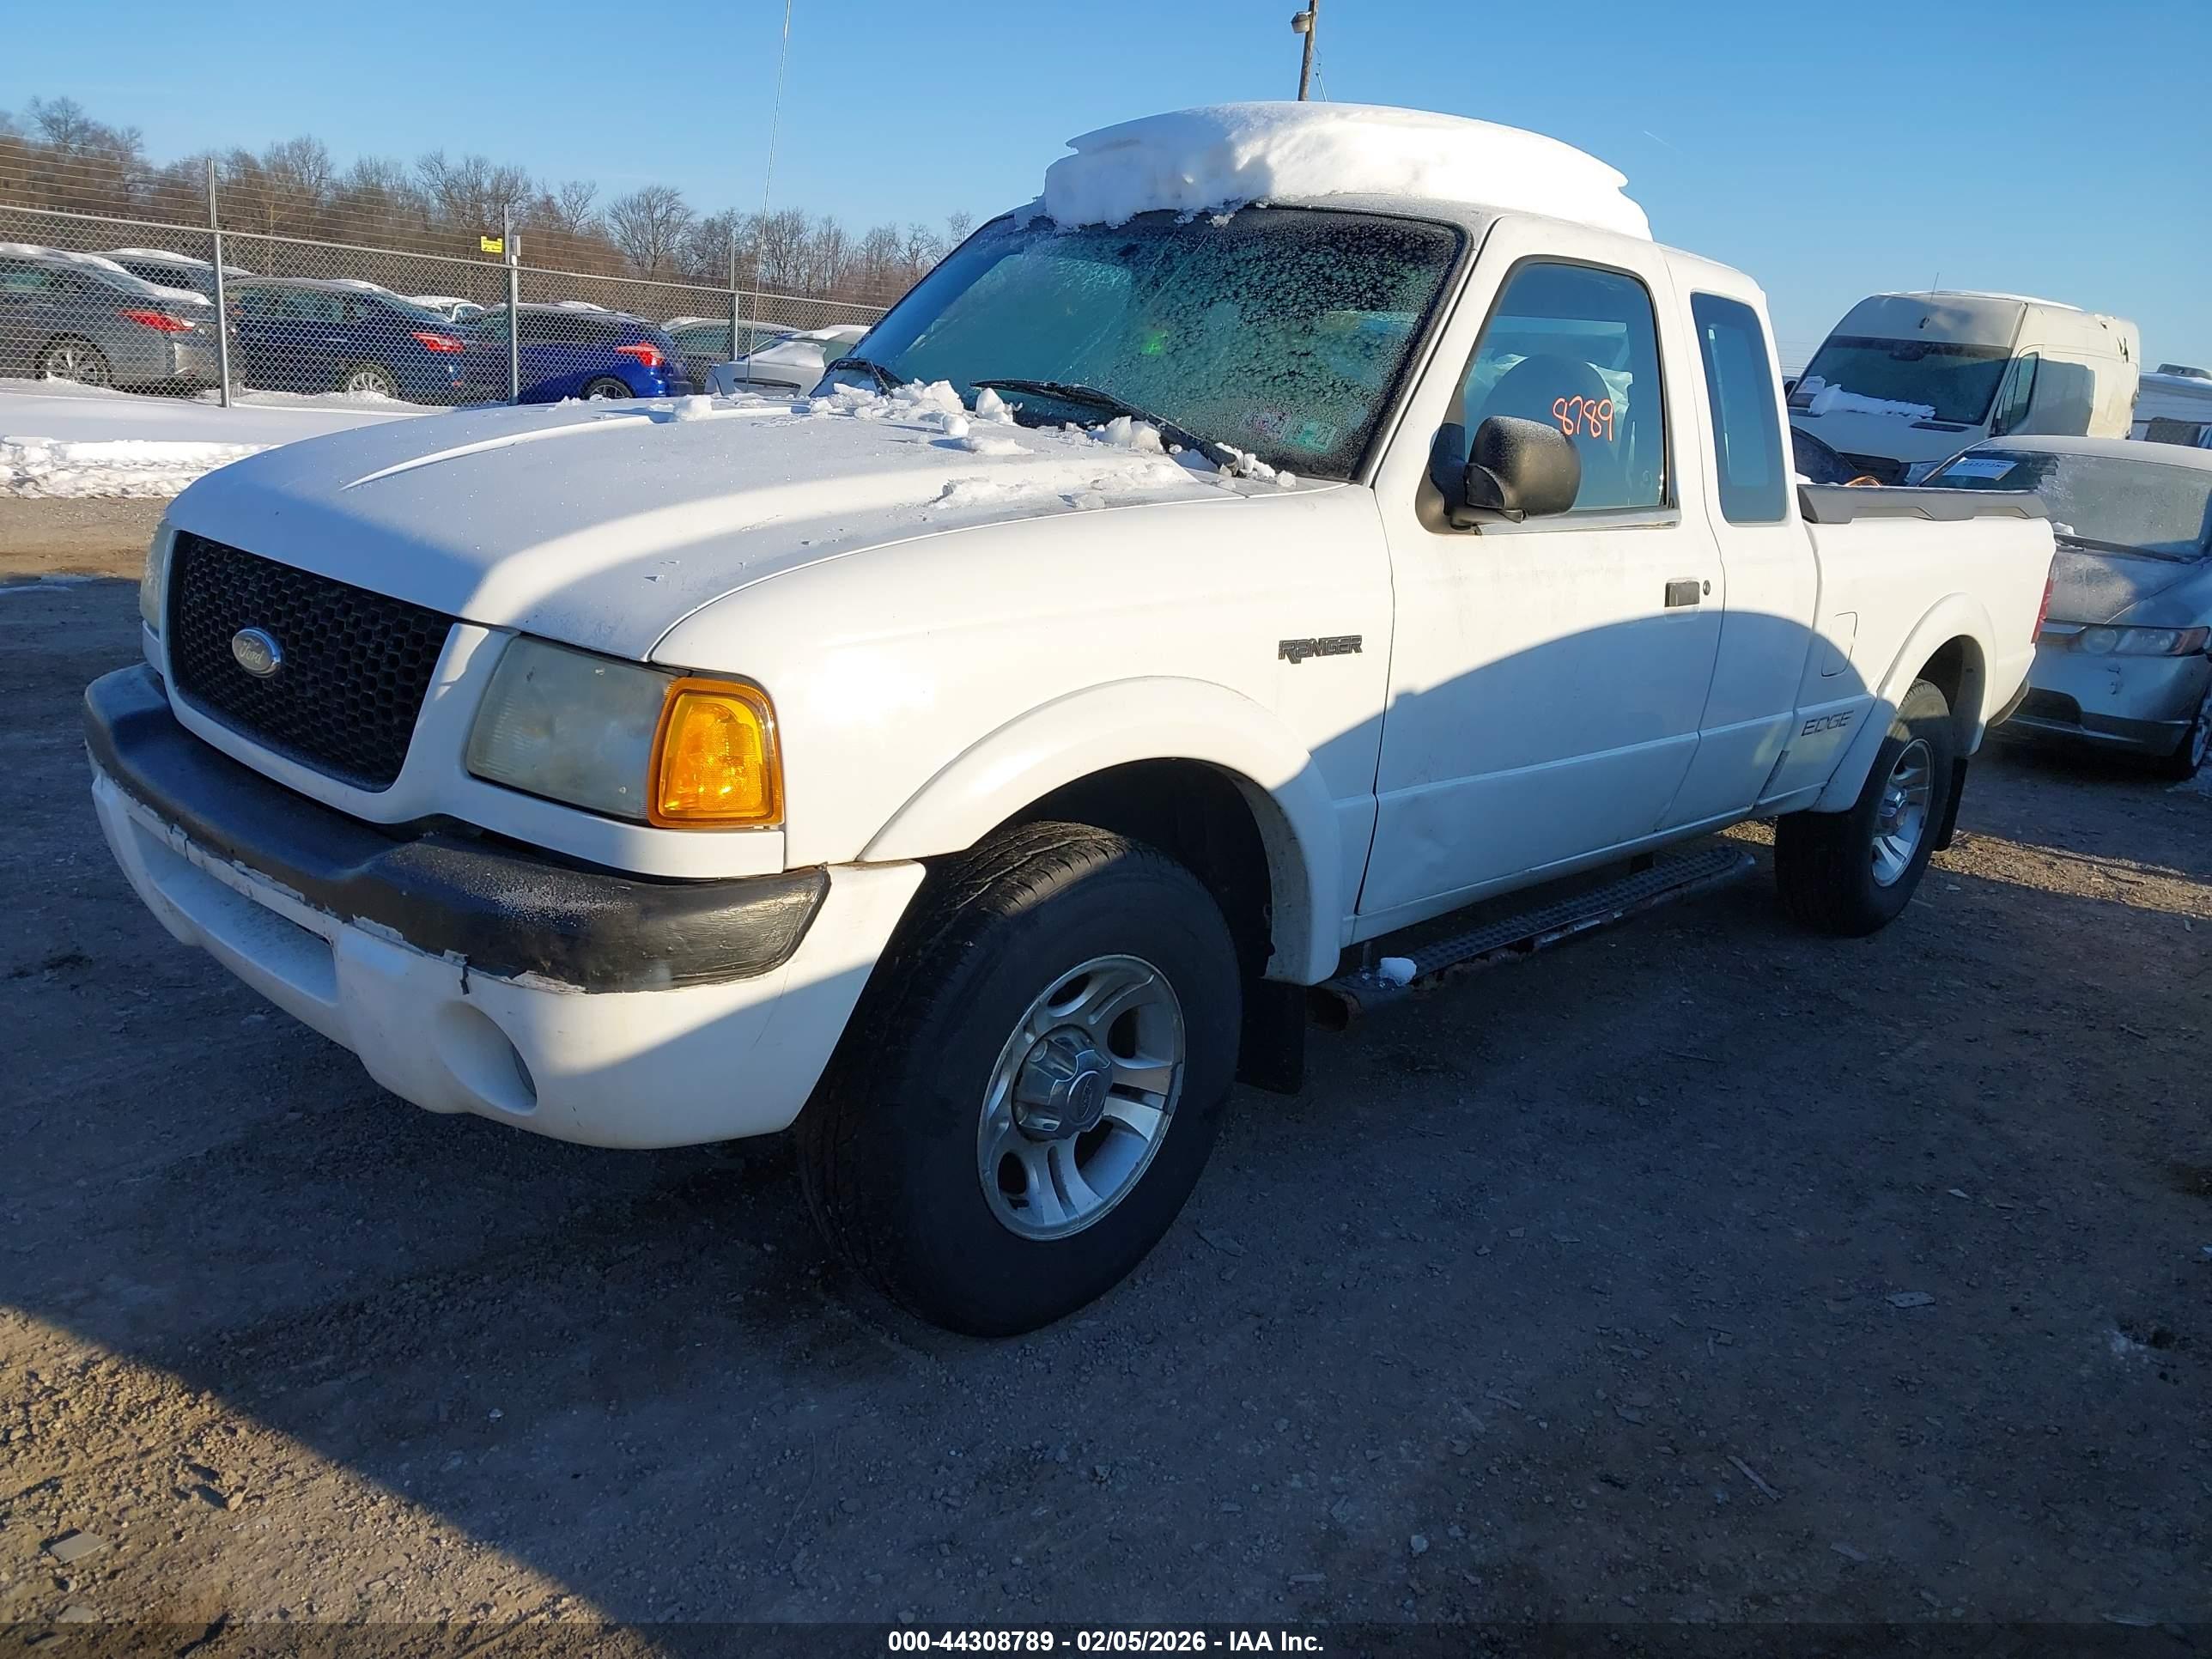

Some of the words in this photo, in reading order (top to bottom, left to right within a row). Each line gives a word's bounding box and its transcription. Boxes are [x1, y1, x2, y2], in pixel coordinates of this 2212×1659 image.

[1553, 395, 1613, 442] 8789
[240, 637, 265, 665] Ford
[1278, 635, 1363, 665] RANGER
[1801, 710, 1855, 737] EDGE
